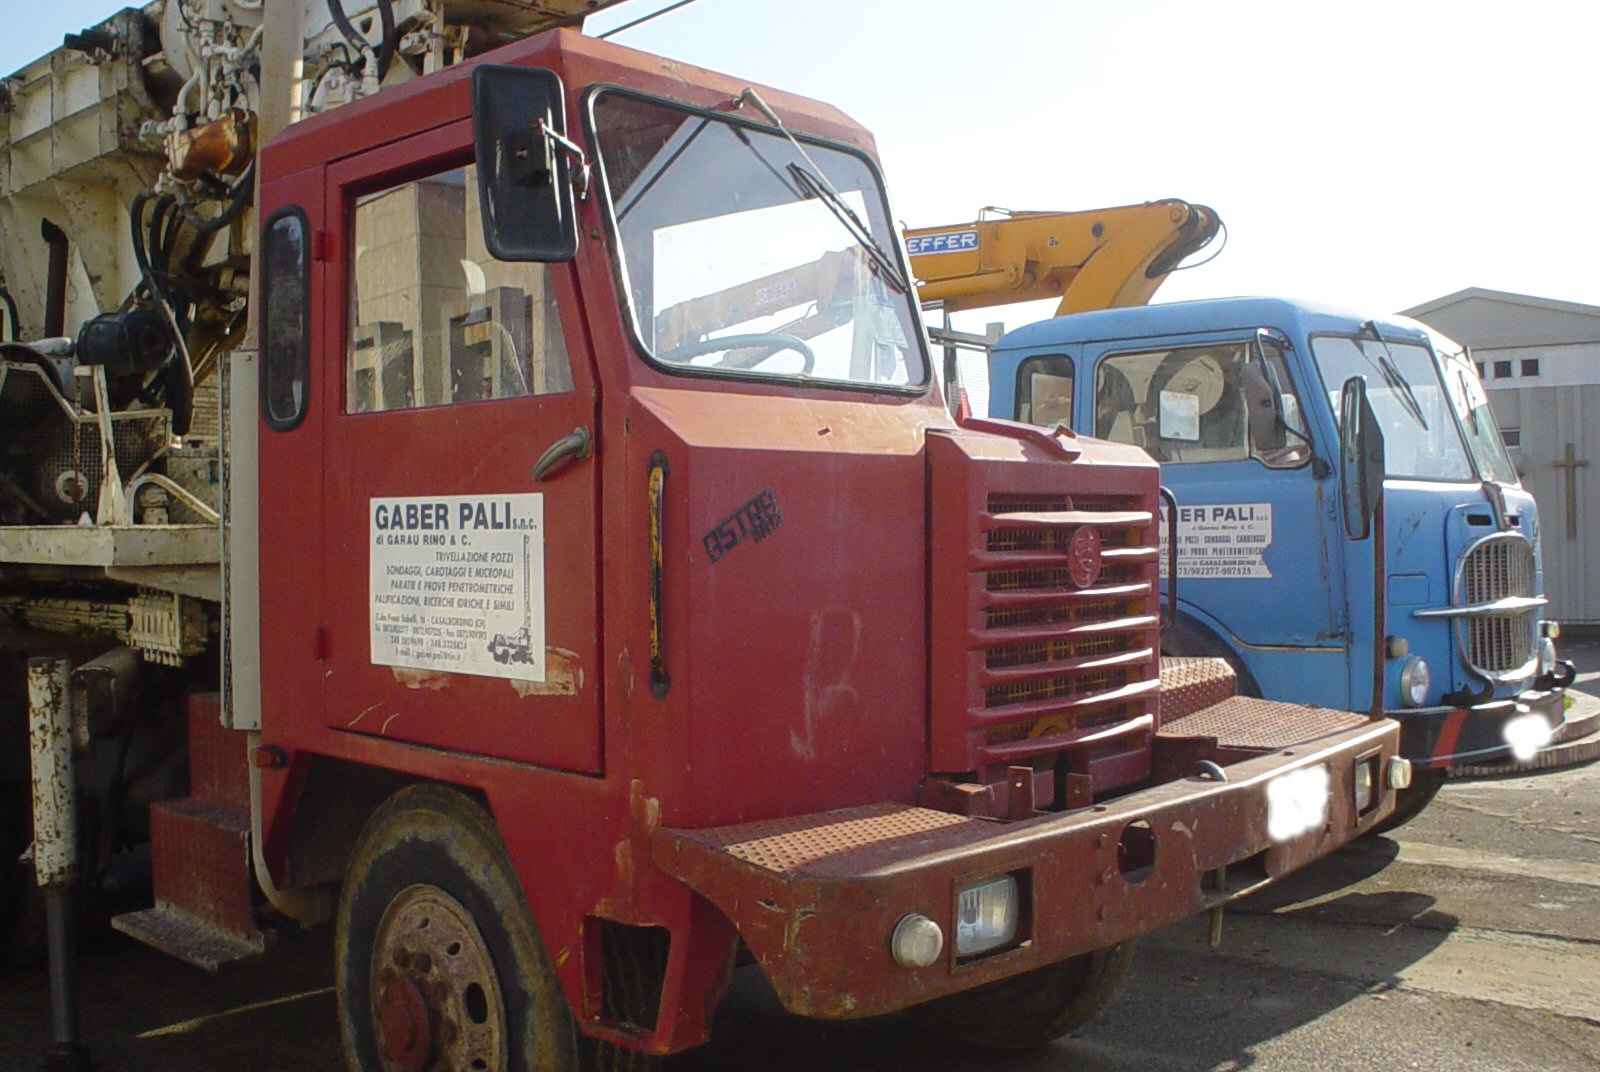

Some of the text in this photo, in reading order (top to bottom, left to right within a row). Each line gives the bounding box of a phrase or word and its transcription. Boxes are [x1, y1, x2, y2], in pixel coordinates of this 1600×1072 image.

[907, 233, 976, 252] EFFER
[375, 503, 449, 530] GABER
[459, 502, 511, 530] PALI
[1160, 508, 1206, 522] AER
[1213, 507, 1254, 521] PALI
[376, 534, 384, 545] di
[387, 534, 419, 546] GARAU
[423, 534, 446, 546] RINO
[450, 534, 456, 546] &
[435, 551, 514, 563] TRIVELLAZIONE POZZI
[425, 565, 466, 577] CAROTAGGI
[468, 566, 473, 577] E
[475, 567, 514, 579] MICROPALI
[390, 579, 416, 591] PARATIE
[424, 580, 446, 592] PROVE
[448, 581, 514, 595] PENETROMETRICHE
[423, 595, 454, 607] RICERCHE
[457, 597, 484, 610] IDRICHE
[493, 599, 514, 611] SIMILI
